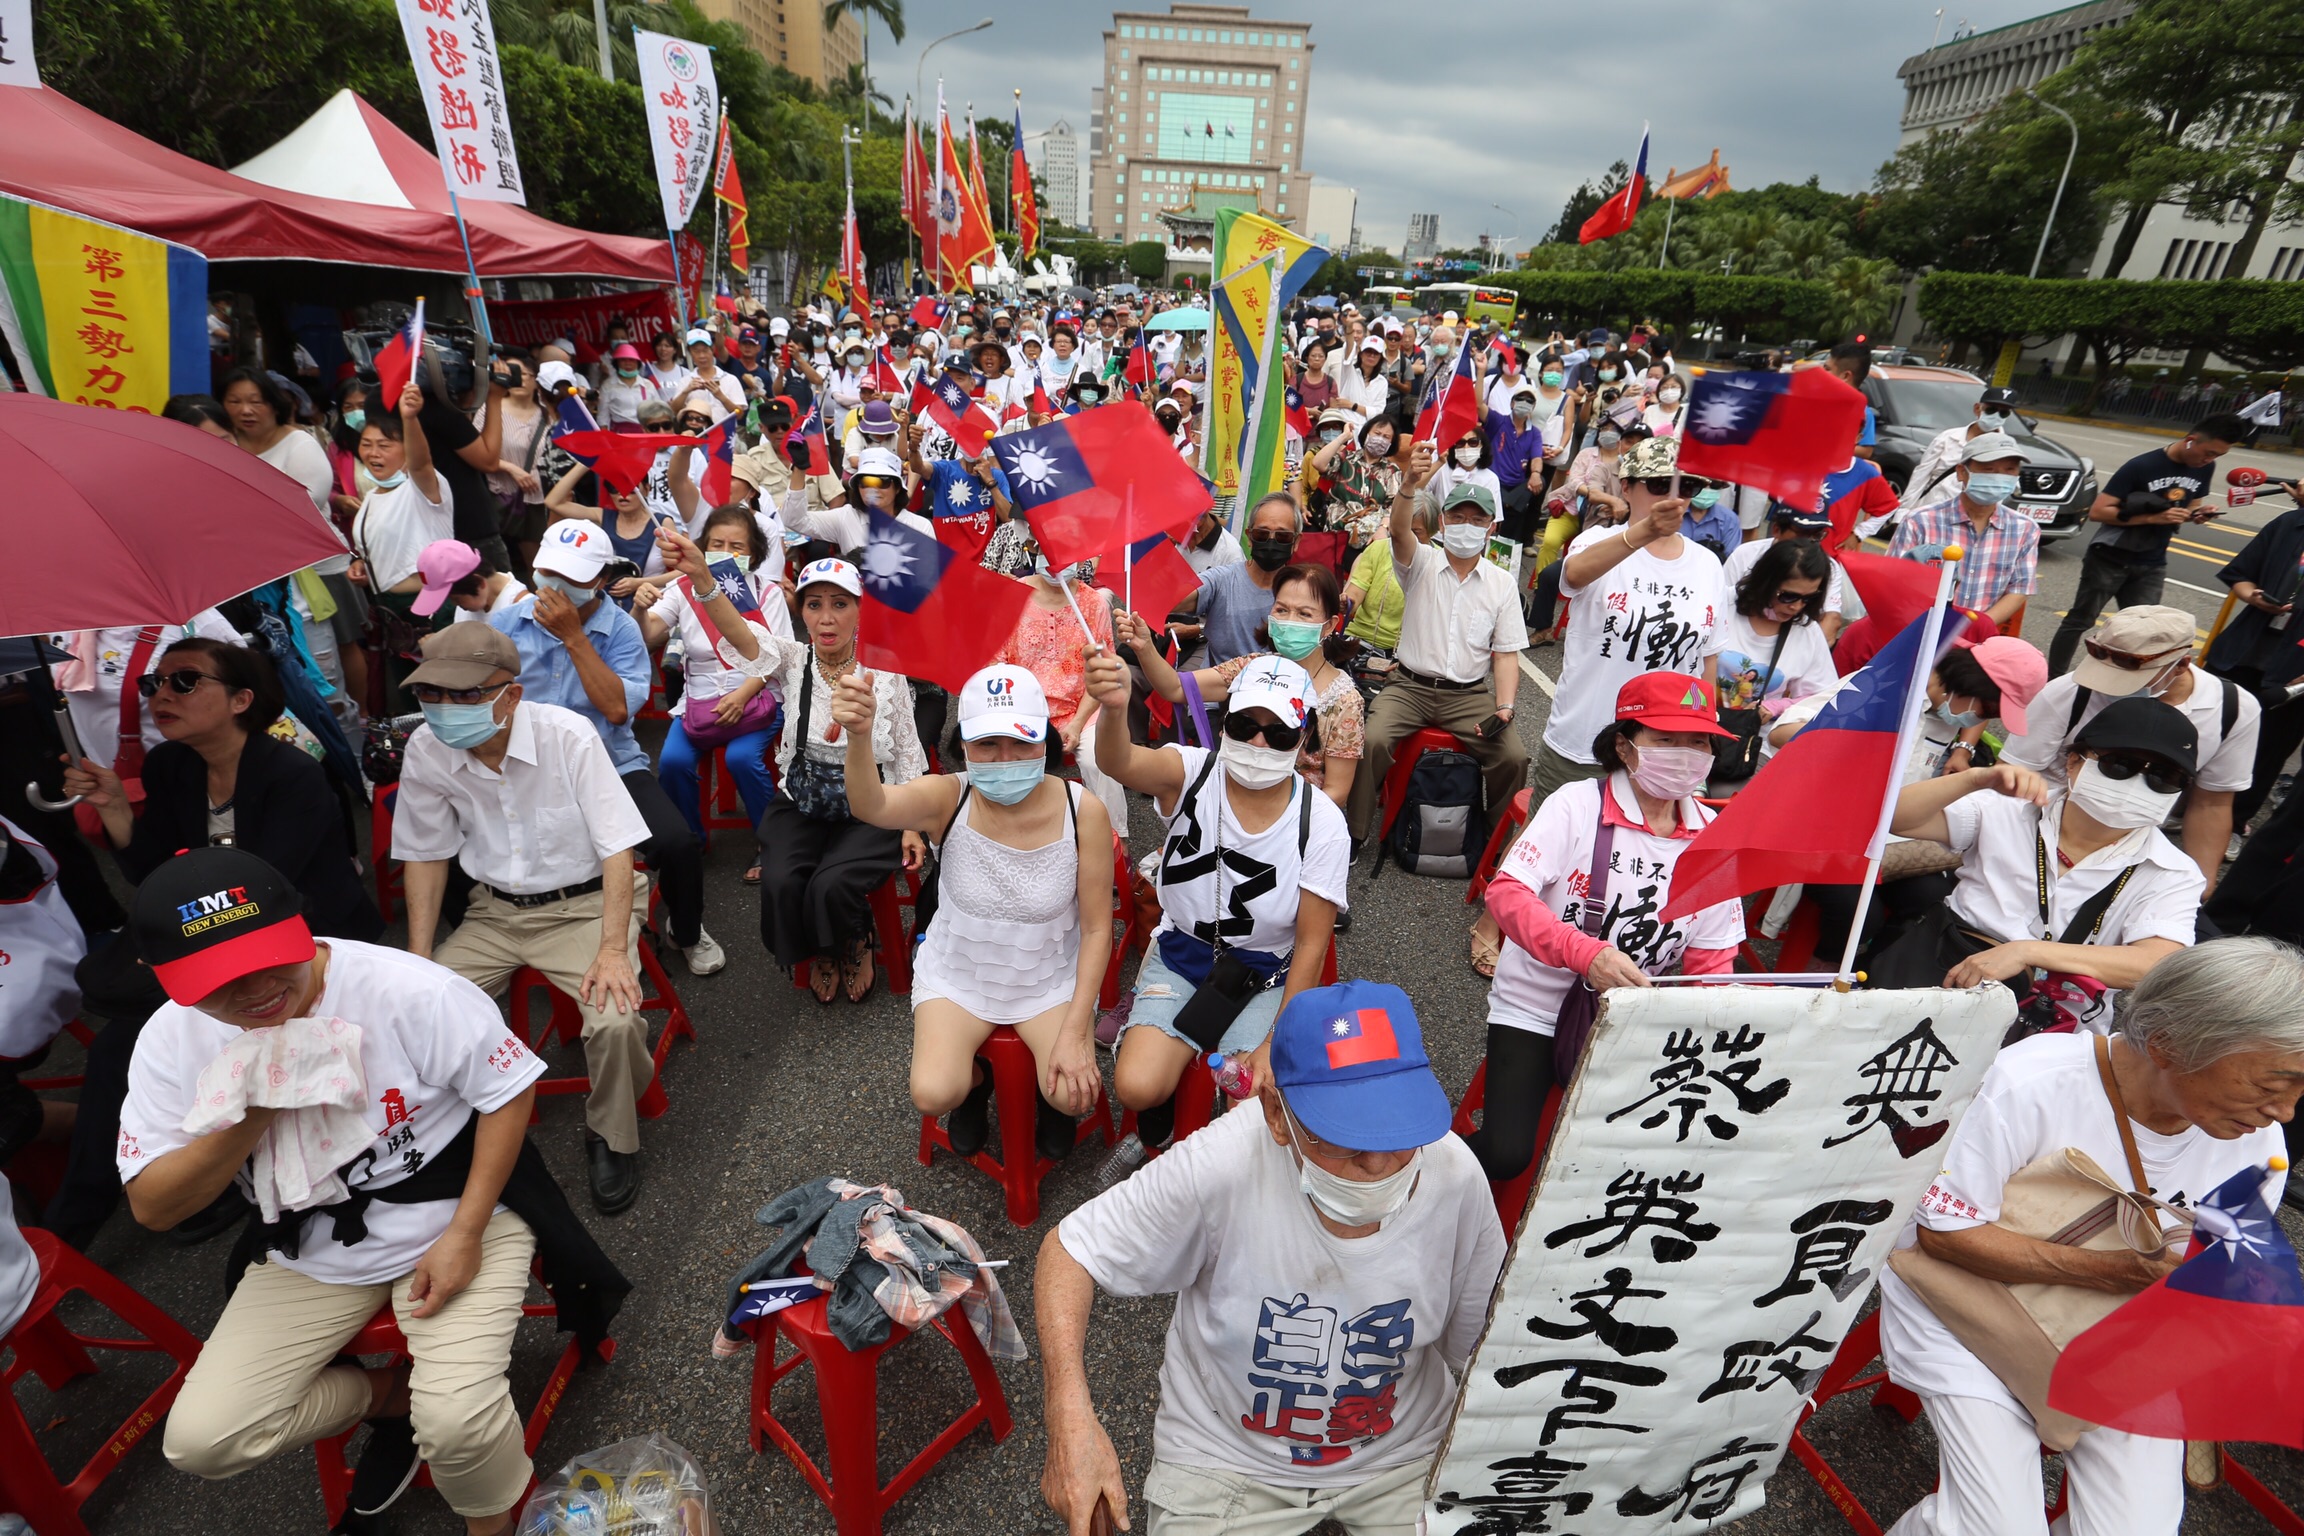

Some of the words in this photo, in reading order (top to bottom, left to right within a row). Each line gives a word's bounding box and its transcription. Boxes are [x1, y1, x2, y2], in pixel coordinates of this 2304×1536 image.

[76, 244, 134, 394] 第三勢力
[559, 528, 588, 548] UP
[1632, 577, 1694, 600] 是非不分
[987, 678, 1014, 695] UP
[177, 886, 248, 923] KMT
[187, 918, 211, 934] NEW
[214, 905, 256, 925] ENERGY
[488, 1034, 519, 1066] 民主監
[110, 1412, 154, 1456] 貝斯特
[1816, 1470, 1856, 1518] 貝斯特
